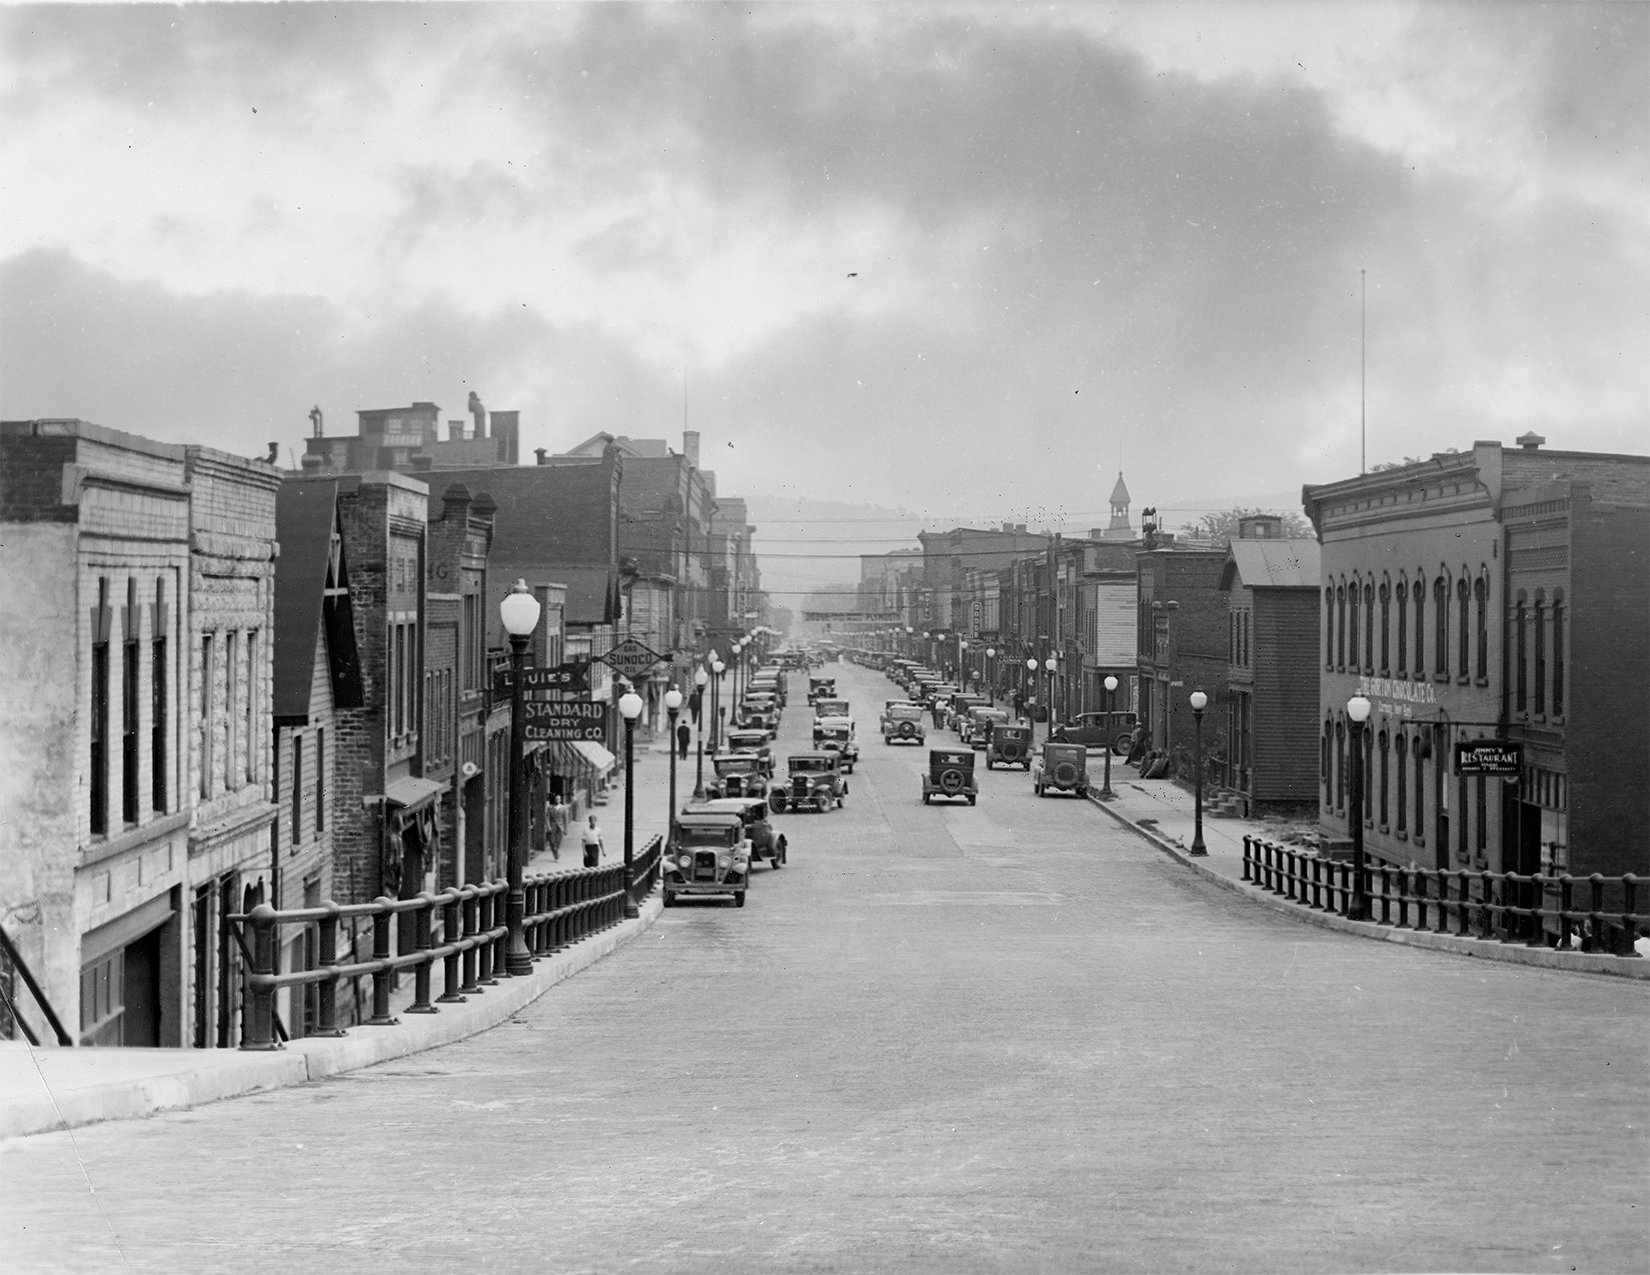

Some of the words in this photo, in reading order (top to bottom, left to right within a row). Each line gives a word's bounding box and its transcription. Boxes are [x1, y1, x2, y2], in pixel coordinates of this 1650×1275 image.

[623, 644, 638, 652] GAS
[609, 653, 652, 666] SUNOCO
[624, 665, 637, 674] OIL
[503, 671, 571, 686] LUIE'S
[525, 702, 603, 719] STANDARD
[549, 718, 580, 727] DRY
[525, 725, 582, 739] CLEANING
[1461, 750, 1518, 765] RESTAURANT
